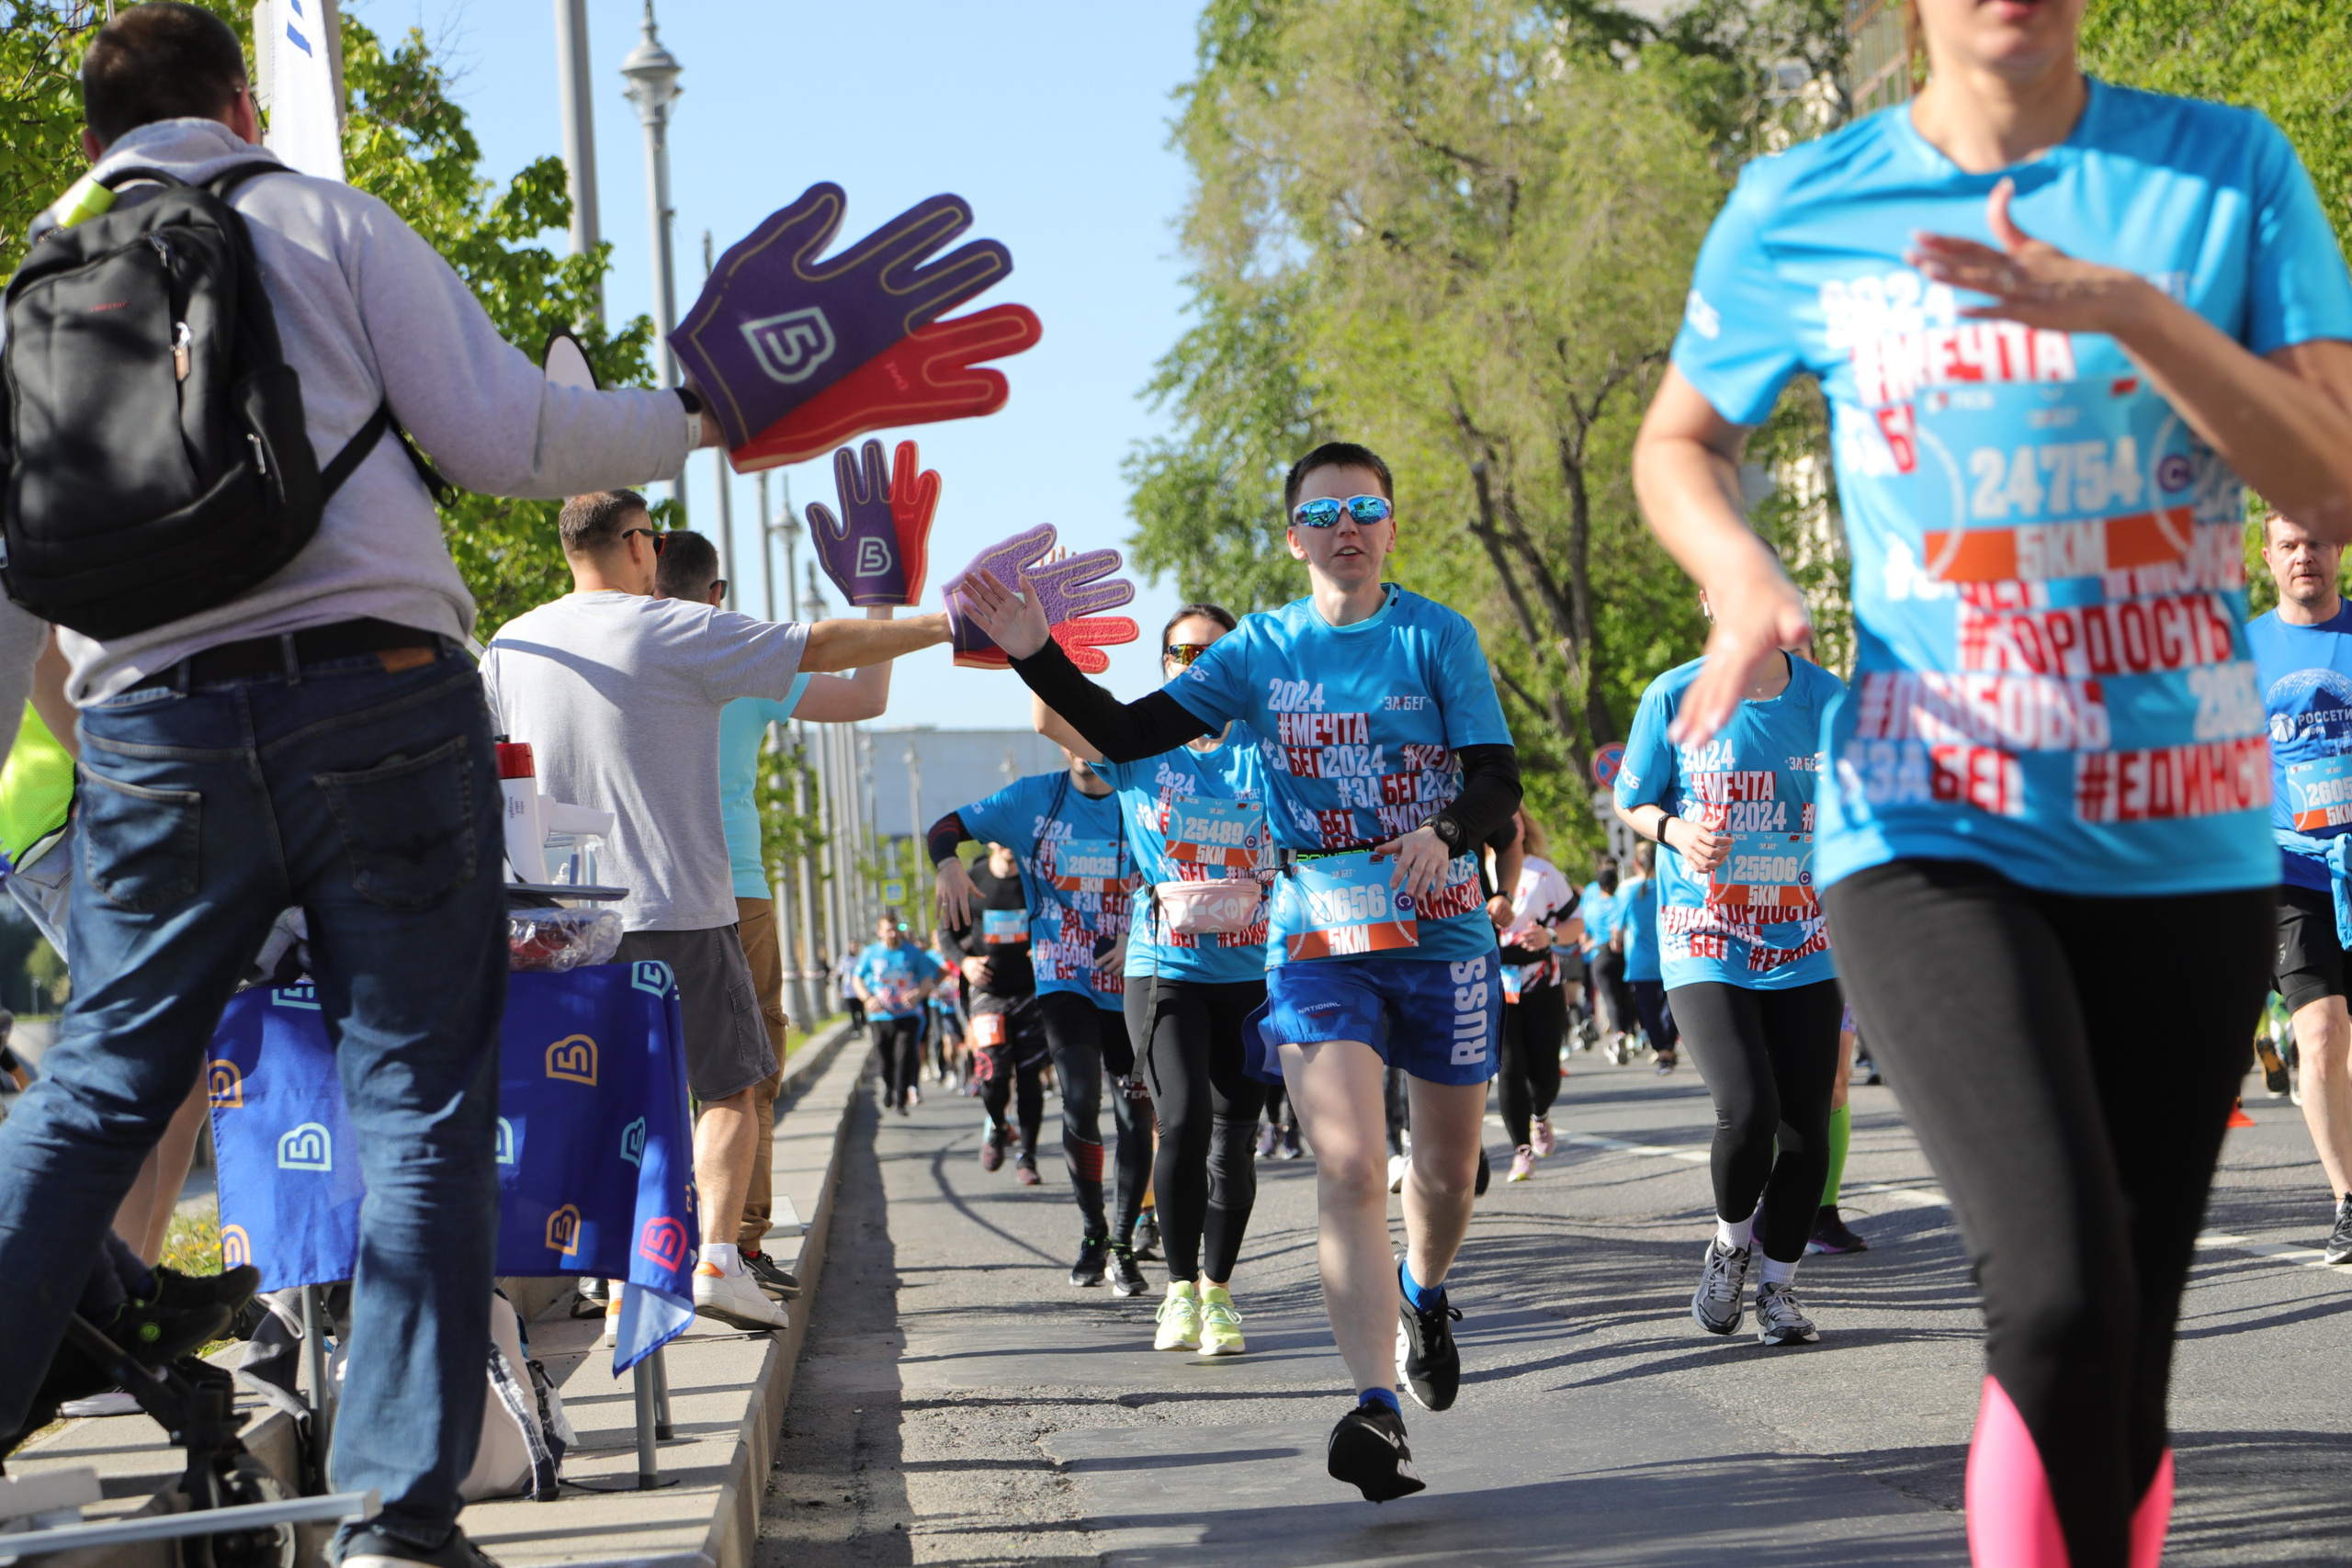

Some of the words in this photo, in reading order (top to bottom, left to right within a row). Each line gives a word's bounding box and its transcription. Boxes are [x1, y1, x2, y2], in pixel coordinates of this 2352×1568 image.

[1969, 436, 2143, 520] 24754
[2016, 520, 2109, 581] 5KM
[1267, 678, 1326, 713] 2024
[1277, 713, 1370, 746] #МЕЧТА
[1680, 739, 1736, 773] 2024
[1690, 772, 1777, 802] #МЕЧТА
[1183, 817, 1245, 845] 25489
[1069, 856, 1117, 875] 20025
[1195, 846, 1227, 865] 5KM
[1733, 854, 1798, 882] 25506
[1080, 876, 1104, 893] 5KM
[1748, 885, 1781, 906] 5KM
[1308, 883, 1386, 927] 21656
[1328, 924, 1371, 956] 5KM
[1297, 1002, 1341, 1015] NATIONAL
